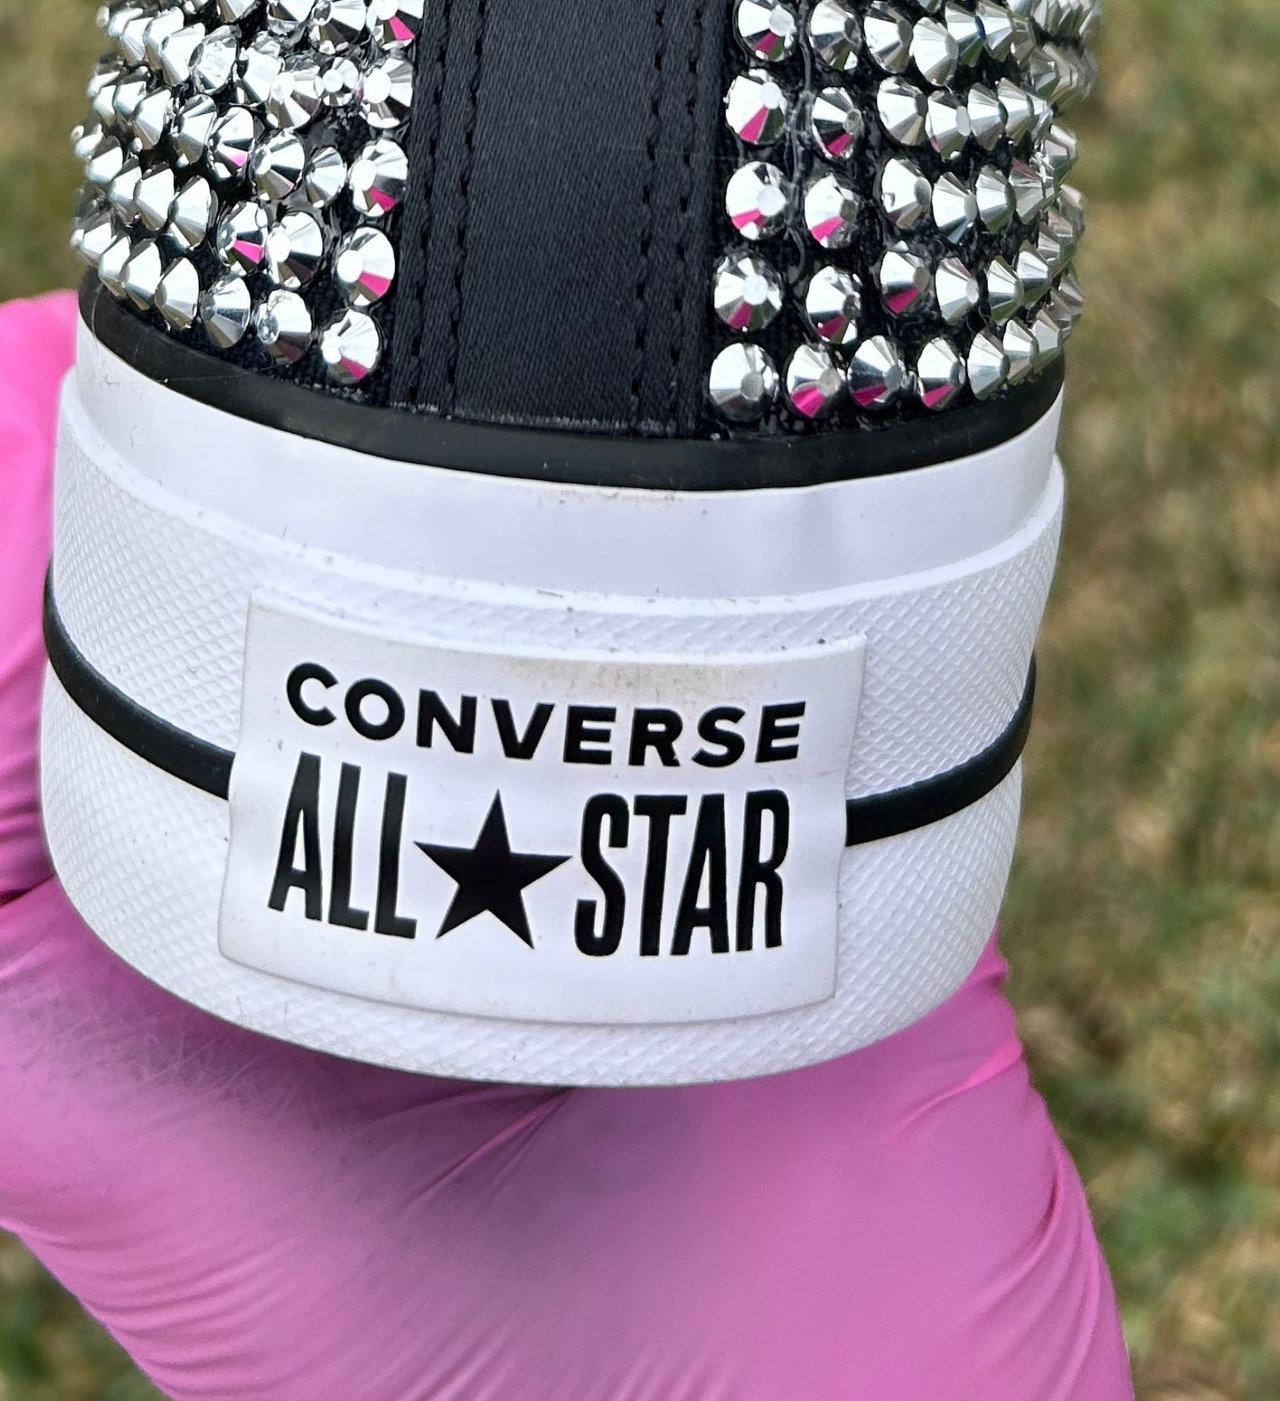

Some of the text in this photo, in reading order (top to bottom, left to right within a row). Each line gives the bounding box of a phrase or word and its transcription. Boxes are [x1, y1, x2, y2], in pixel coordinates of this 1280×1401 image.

[285, 661, 806, 768] CONVERSE
[267, 751, 790, 957] ALL STAR
